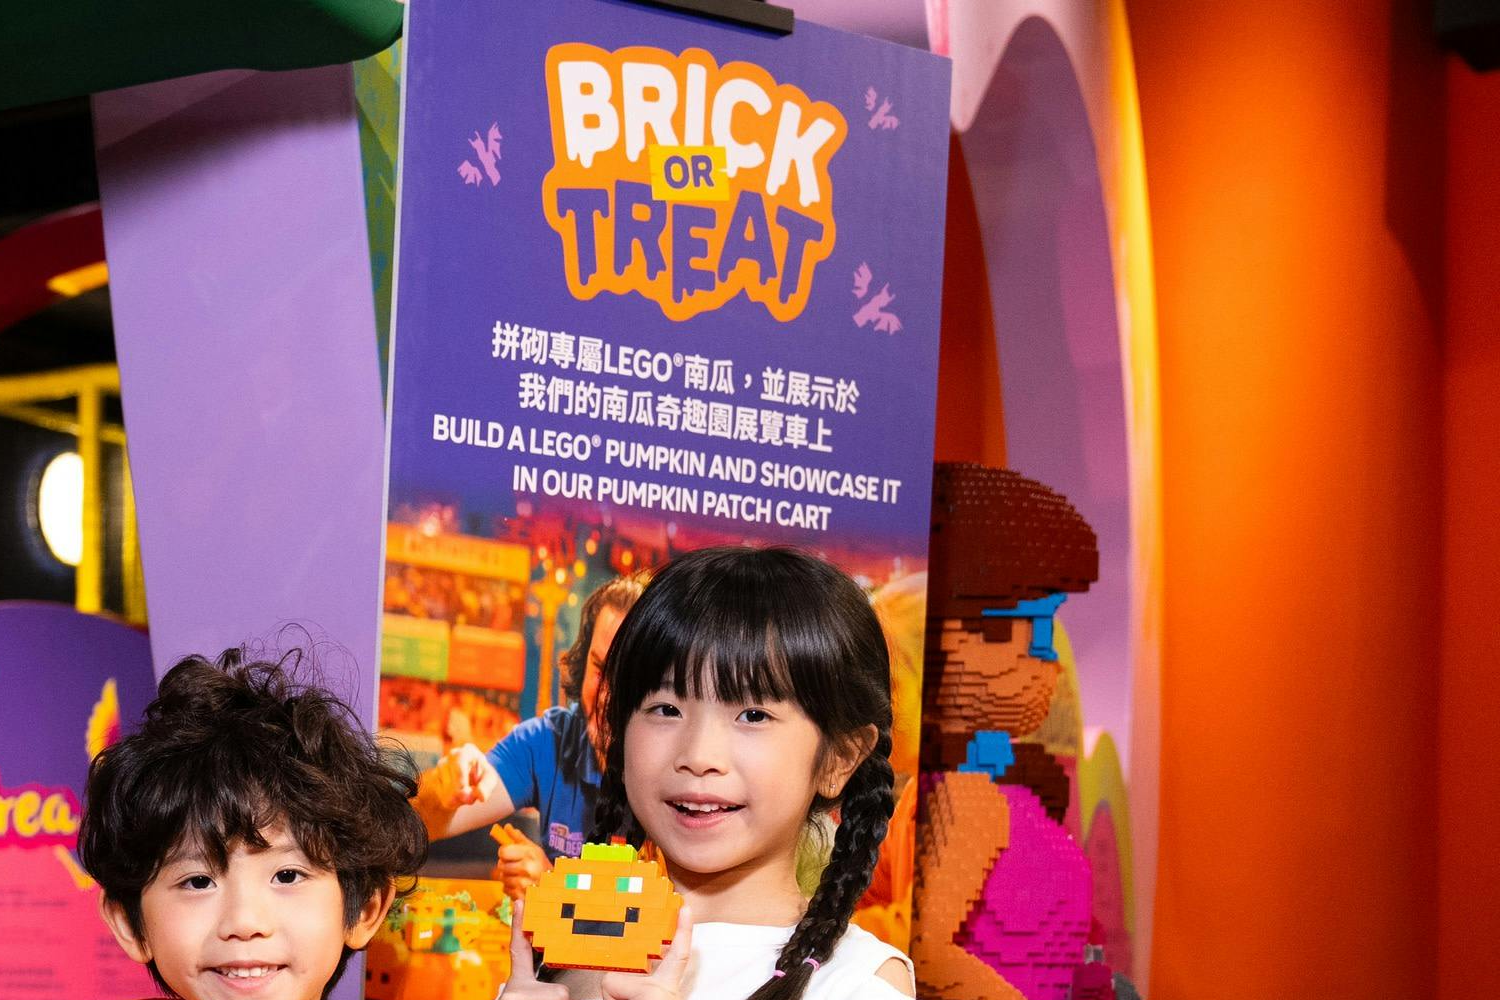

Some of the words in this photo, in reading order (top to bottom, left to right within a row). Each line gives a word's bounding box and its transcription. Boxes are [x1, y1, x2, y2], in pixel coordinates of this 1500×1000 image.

[558, 61, 835, 207] BRICK
[663, 155, 714, 190] OR
[556, 179, 824, 304] TREAT
[518, 372, 834, 453] 我們的南瓜奇趣園展覽車上
[432, 413, 505, 449] BUILD
[507, 425, 526, 452] A
[605, 438, 706, 477] PUMPKIN
[708, 454, 757, 485] AND
[759, 460, 880, 502] SHOWCASE
[882, 478, 902, 505] IT
[513, 464, 538, 494] IN
[542, 469, 593, 501] OUR
[597, 476, 698, 514] PUMPKIN
[702, 490, 772, 524] PATCH
[775, 500, 833, 531] CART
